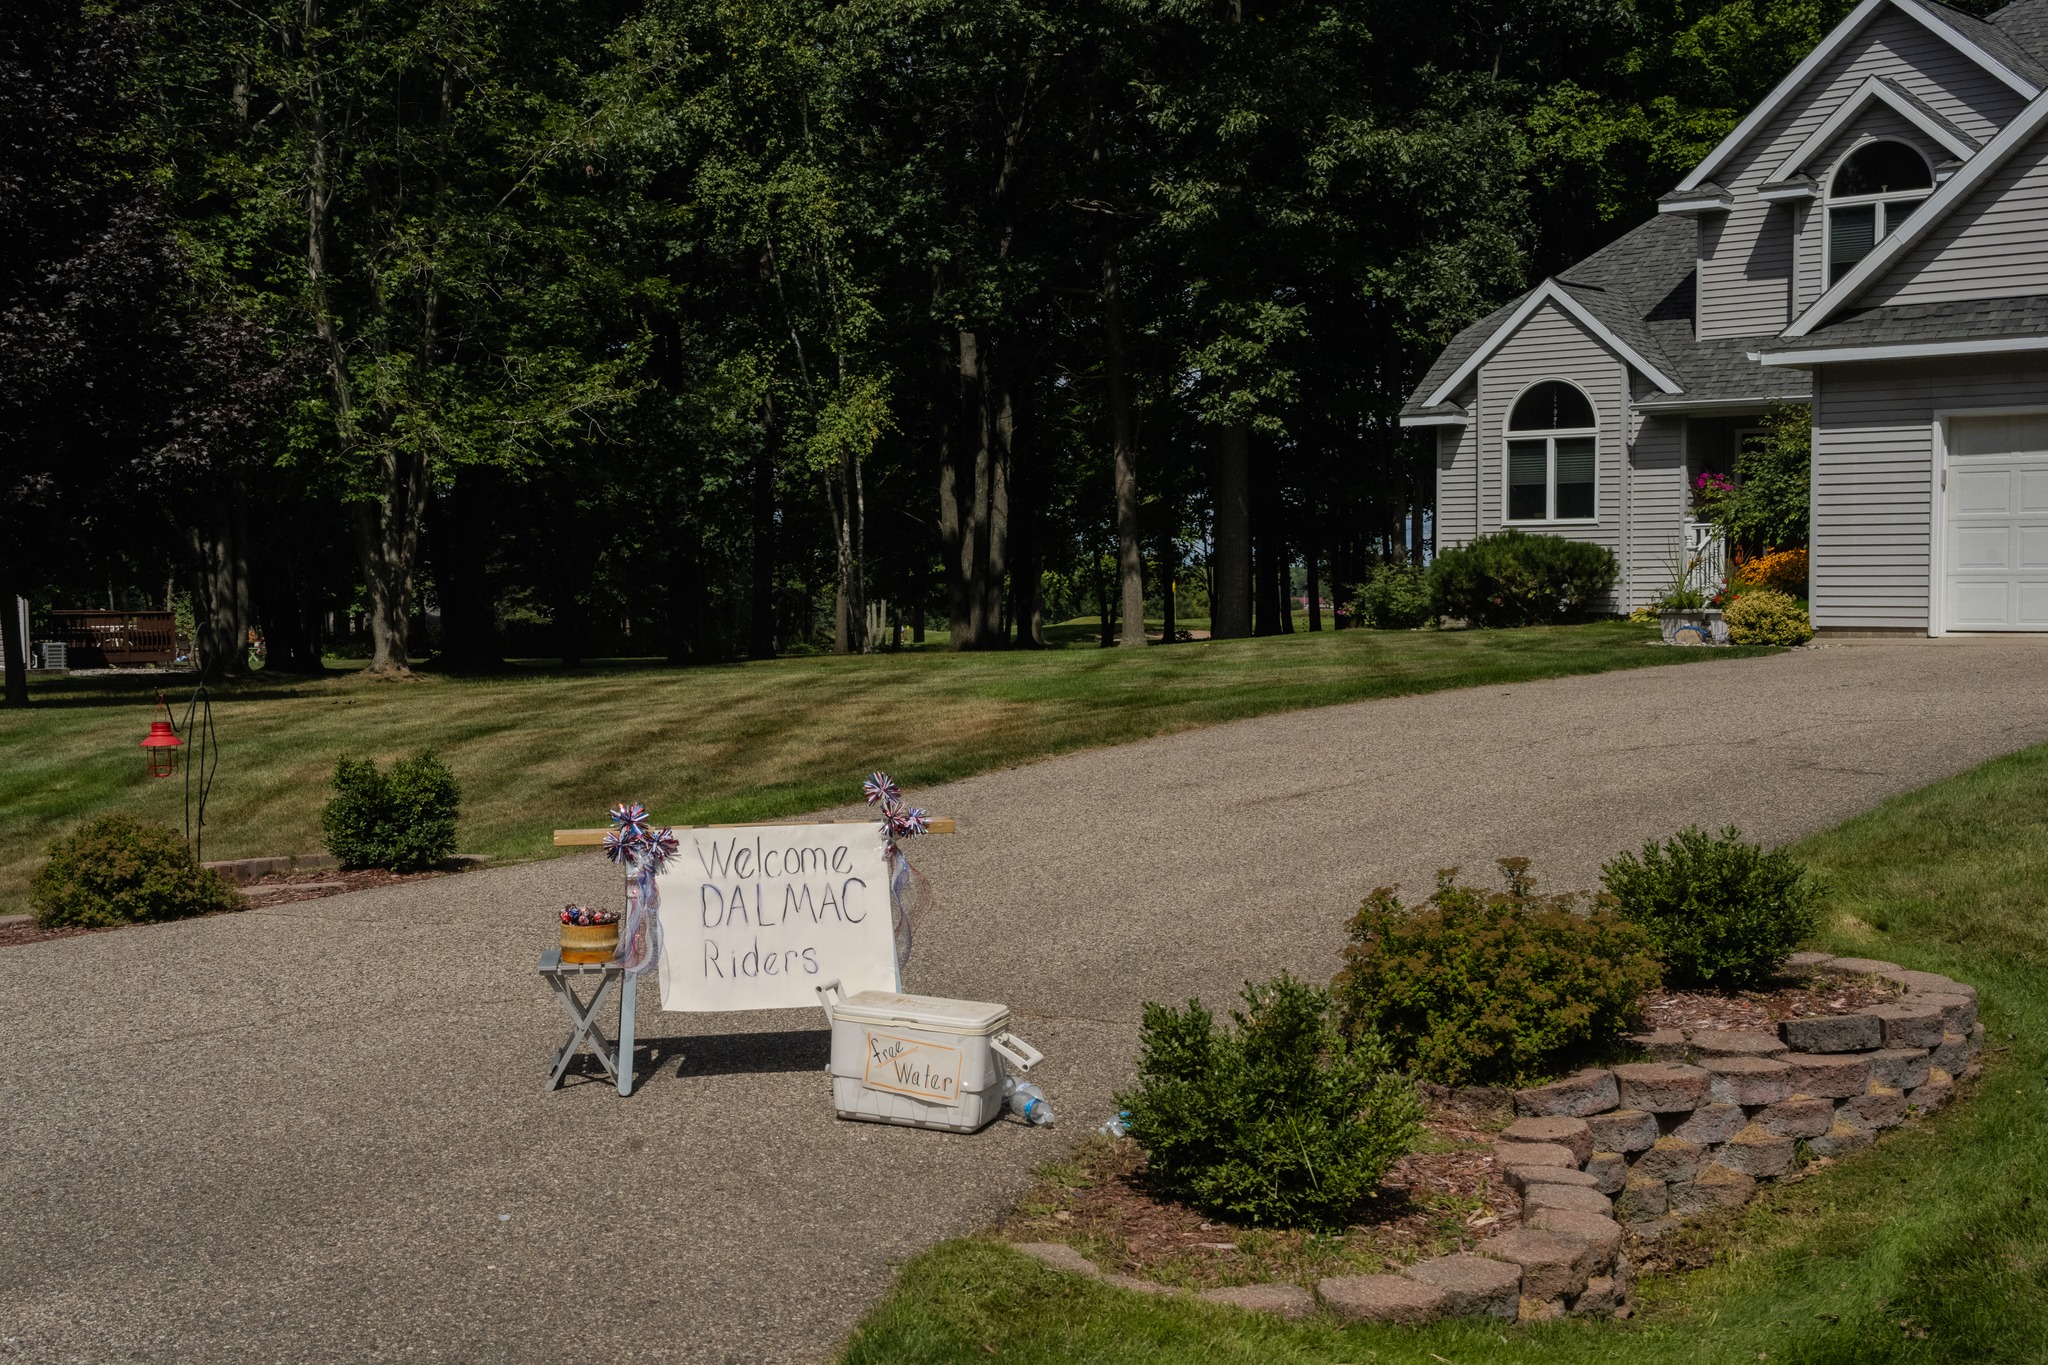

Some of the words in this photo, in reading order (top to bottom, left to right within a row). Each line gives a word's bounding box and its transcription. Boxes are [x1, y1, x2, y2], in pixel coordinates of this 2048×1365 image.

[696, 836, 853, 879] Welcome
[701, 877, 867, 928] DALMAC
[704, 937, 819, 978] Riders
[894, 1060, 953, 1092] Water
